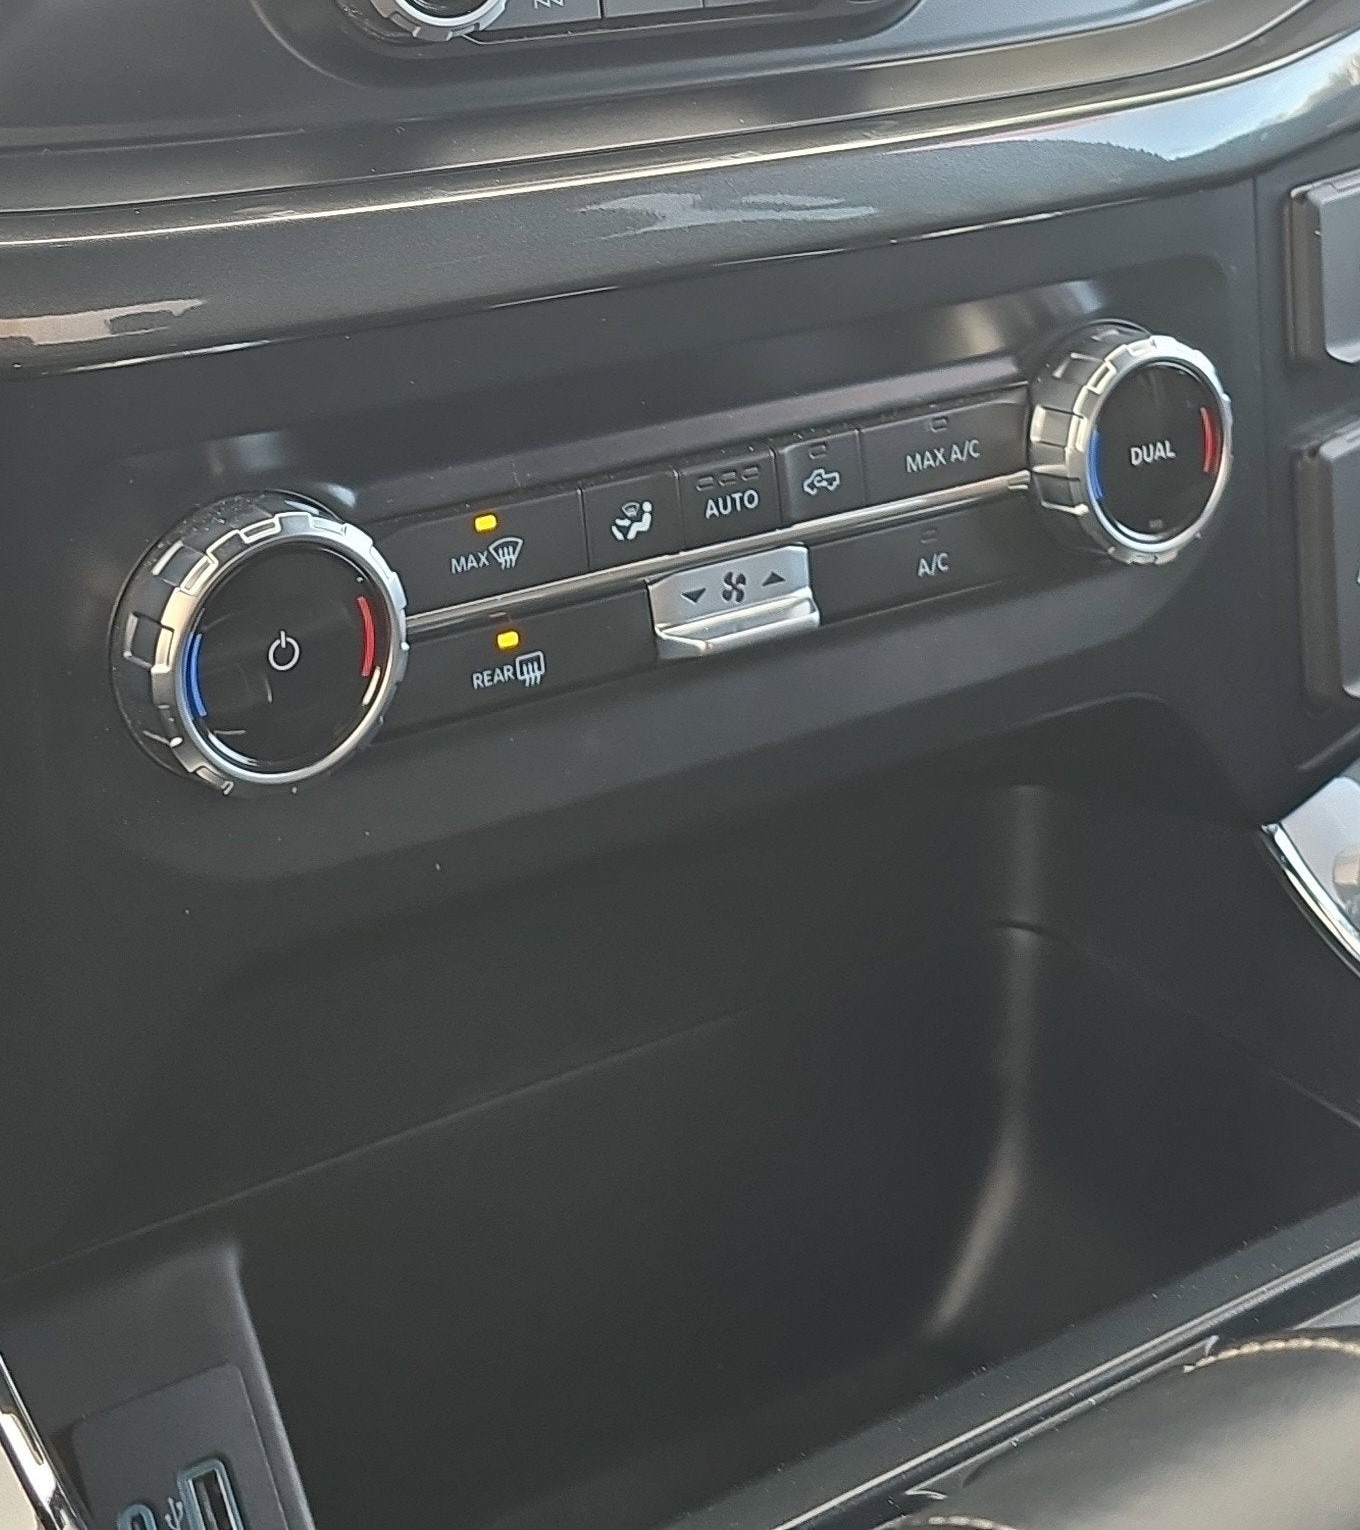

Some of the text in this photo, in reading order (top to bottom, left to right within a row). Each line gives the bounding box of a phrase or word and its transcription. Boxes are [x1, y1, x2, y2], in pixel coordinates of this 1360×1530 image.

[905, 439, 981, 473] MAX A/C
[1129, 441, 1177, 466] DUAL
[704, 489, 760, 520] AUTO
[450, 552, 490, 575] MAX
[917, 552, 950, 578] A/C
[472, 664, 516, 690] REAR
